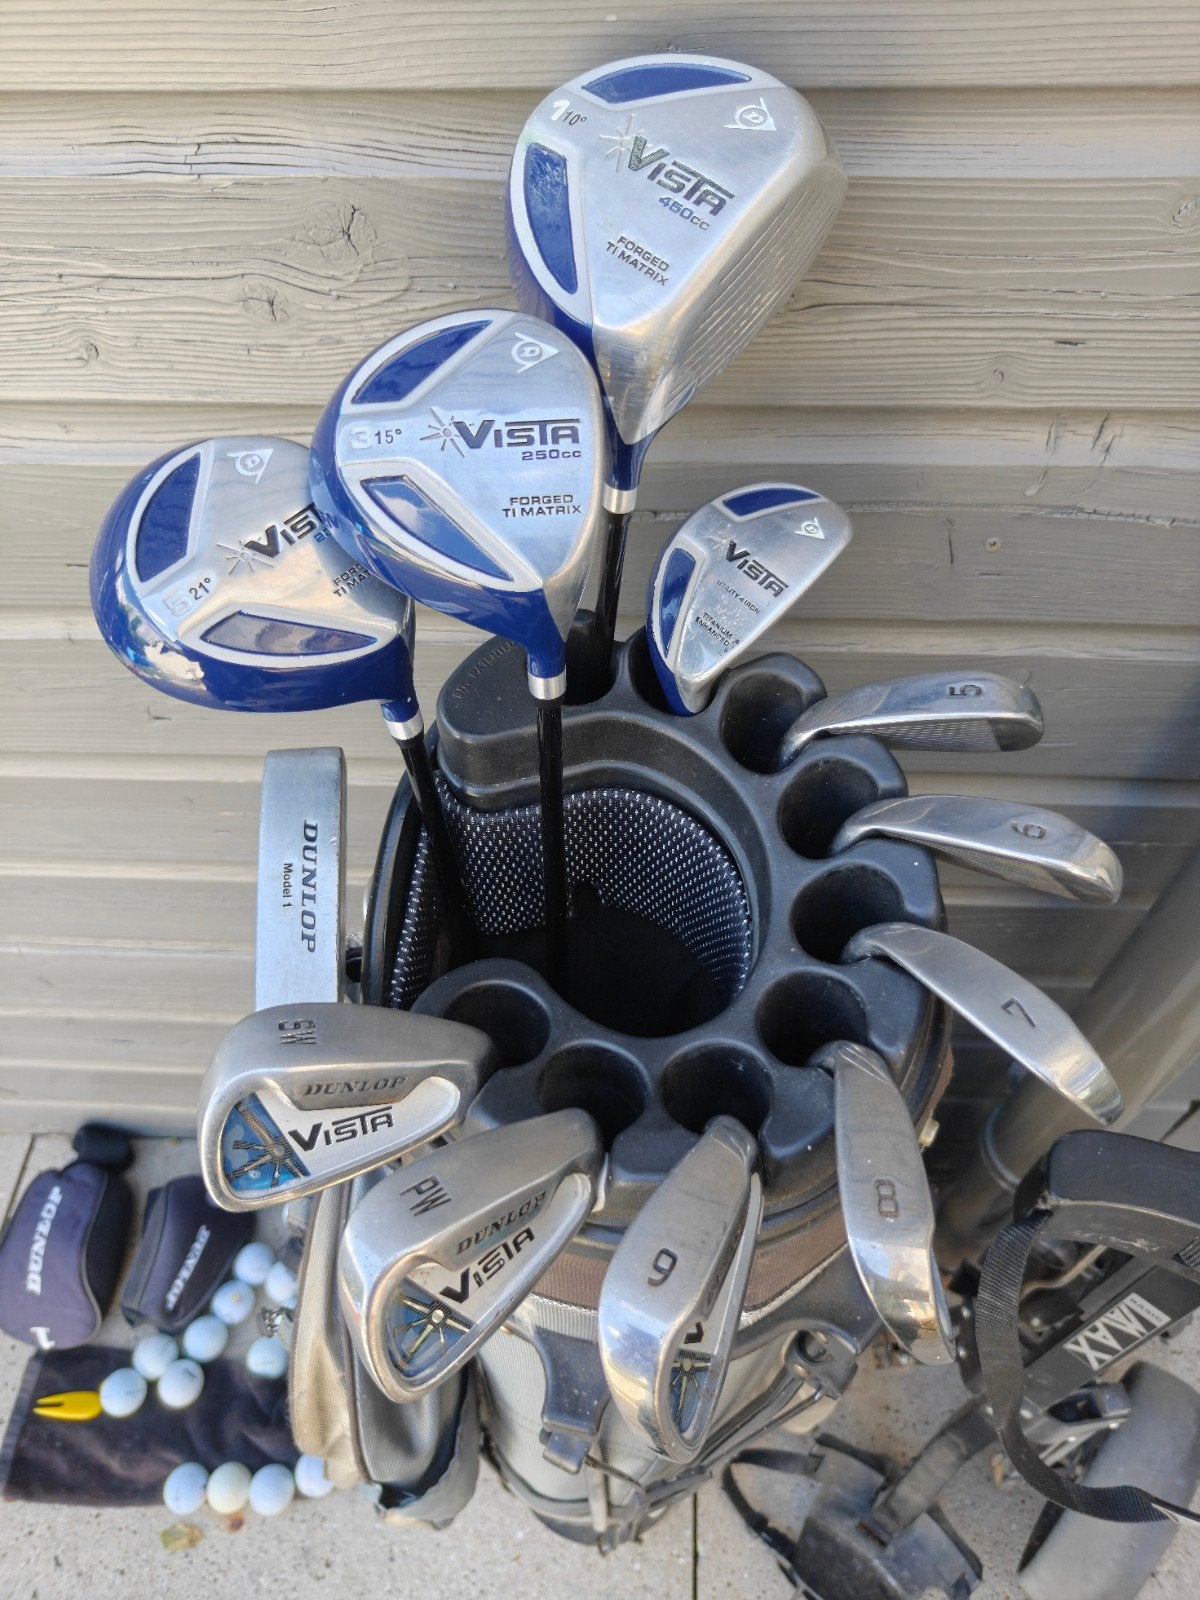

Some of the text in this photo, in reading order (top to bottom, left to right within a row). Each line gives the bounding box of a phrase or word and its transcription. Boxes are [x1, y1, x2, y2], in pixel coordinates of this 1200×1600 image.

[627, 135, 735, 217] VISTA
[659, 195, 710, 231] 450cc
[605, 241, 669, 286] TI MATRIX
[616, 235, 670, 272] FORGED
[451, 418, 581, 449] VISTA
[521, 449, 582, 461] 250cc
[502, 505, 582, 518] TI MATRIX
[509, 494, 574, 506] FORGED
[725, 540, 789, 598] VISTA
[717, 579, 740, 598] UTILITY
[743, 599, 761, 615] IRON
[695, 616, 730, 647] ENHANCED
[702, 612, 733, 639] TITANIUM
[948, 684, 982, 698] 5
[283, 863, 293, 901] Model
[301, 819, 318, 953] DUNLOP
[1001, 996, 1036, 1028] 7
[303, 1077, 408, 1097] DUNLOP
[288, 1105, 395, 1152] VISTA
[400, 1174, 452, 1217] PW
[875, 1178, 899, 1217] 8
[456, 1190, 547, 1256] DUNLOP
[439, 1227, 535, 1304] VISTA
[647, 1247, 678, 1287] 9
